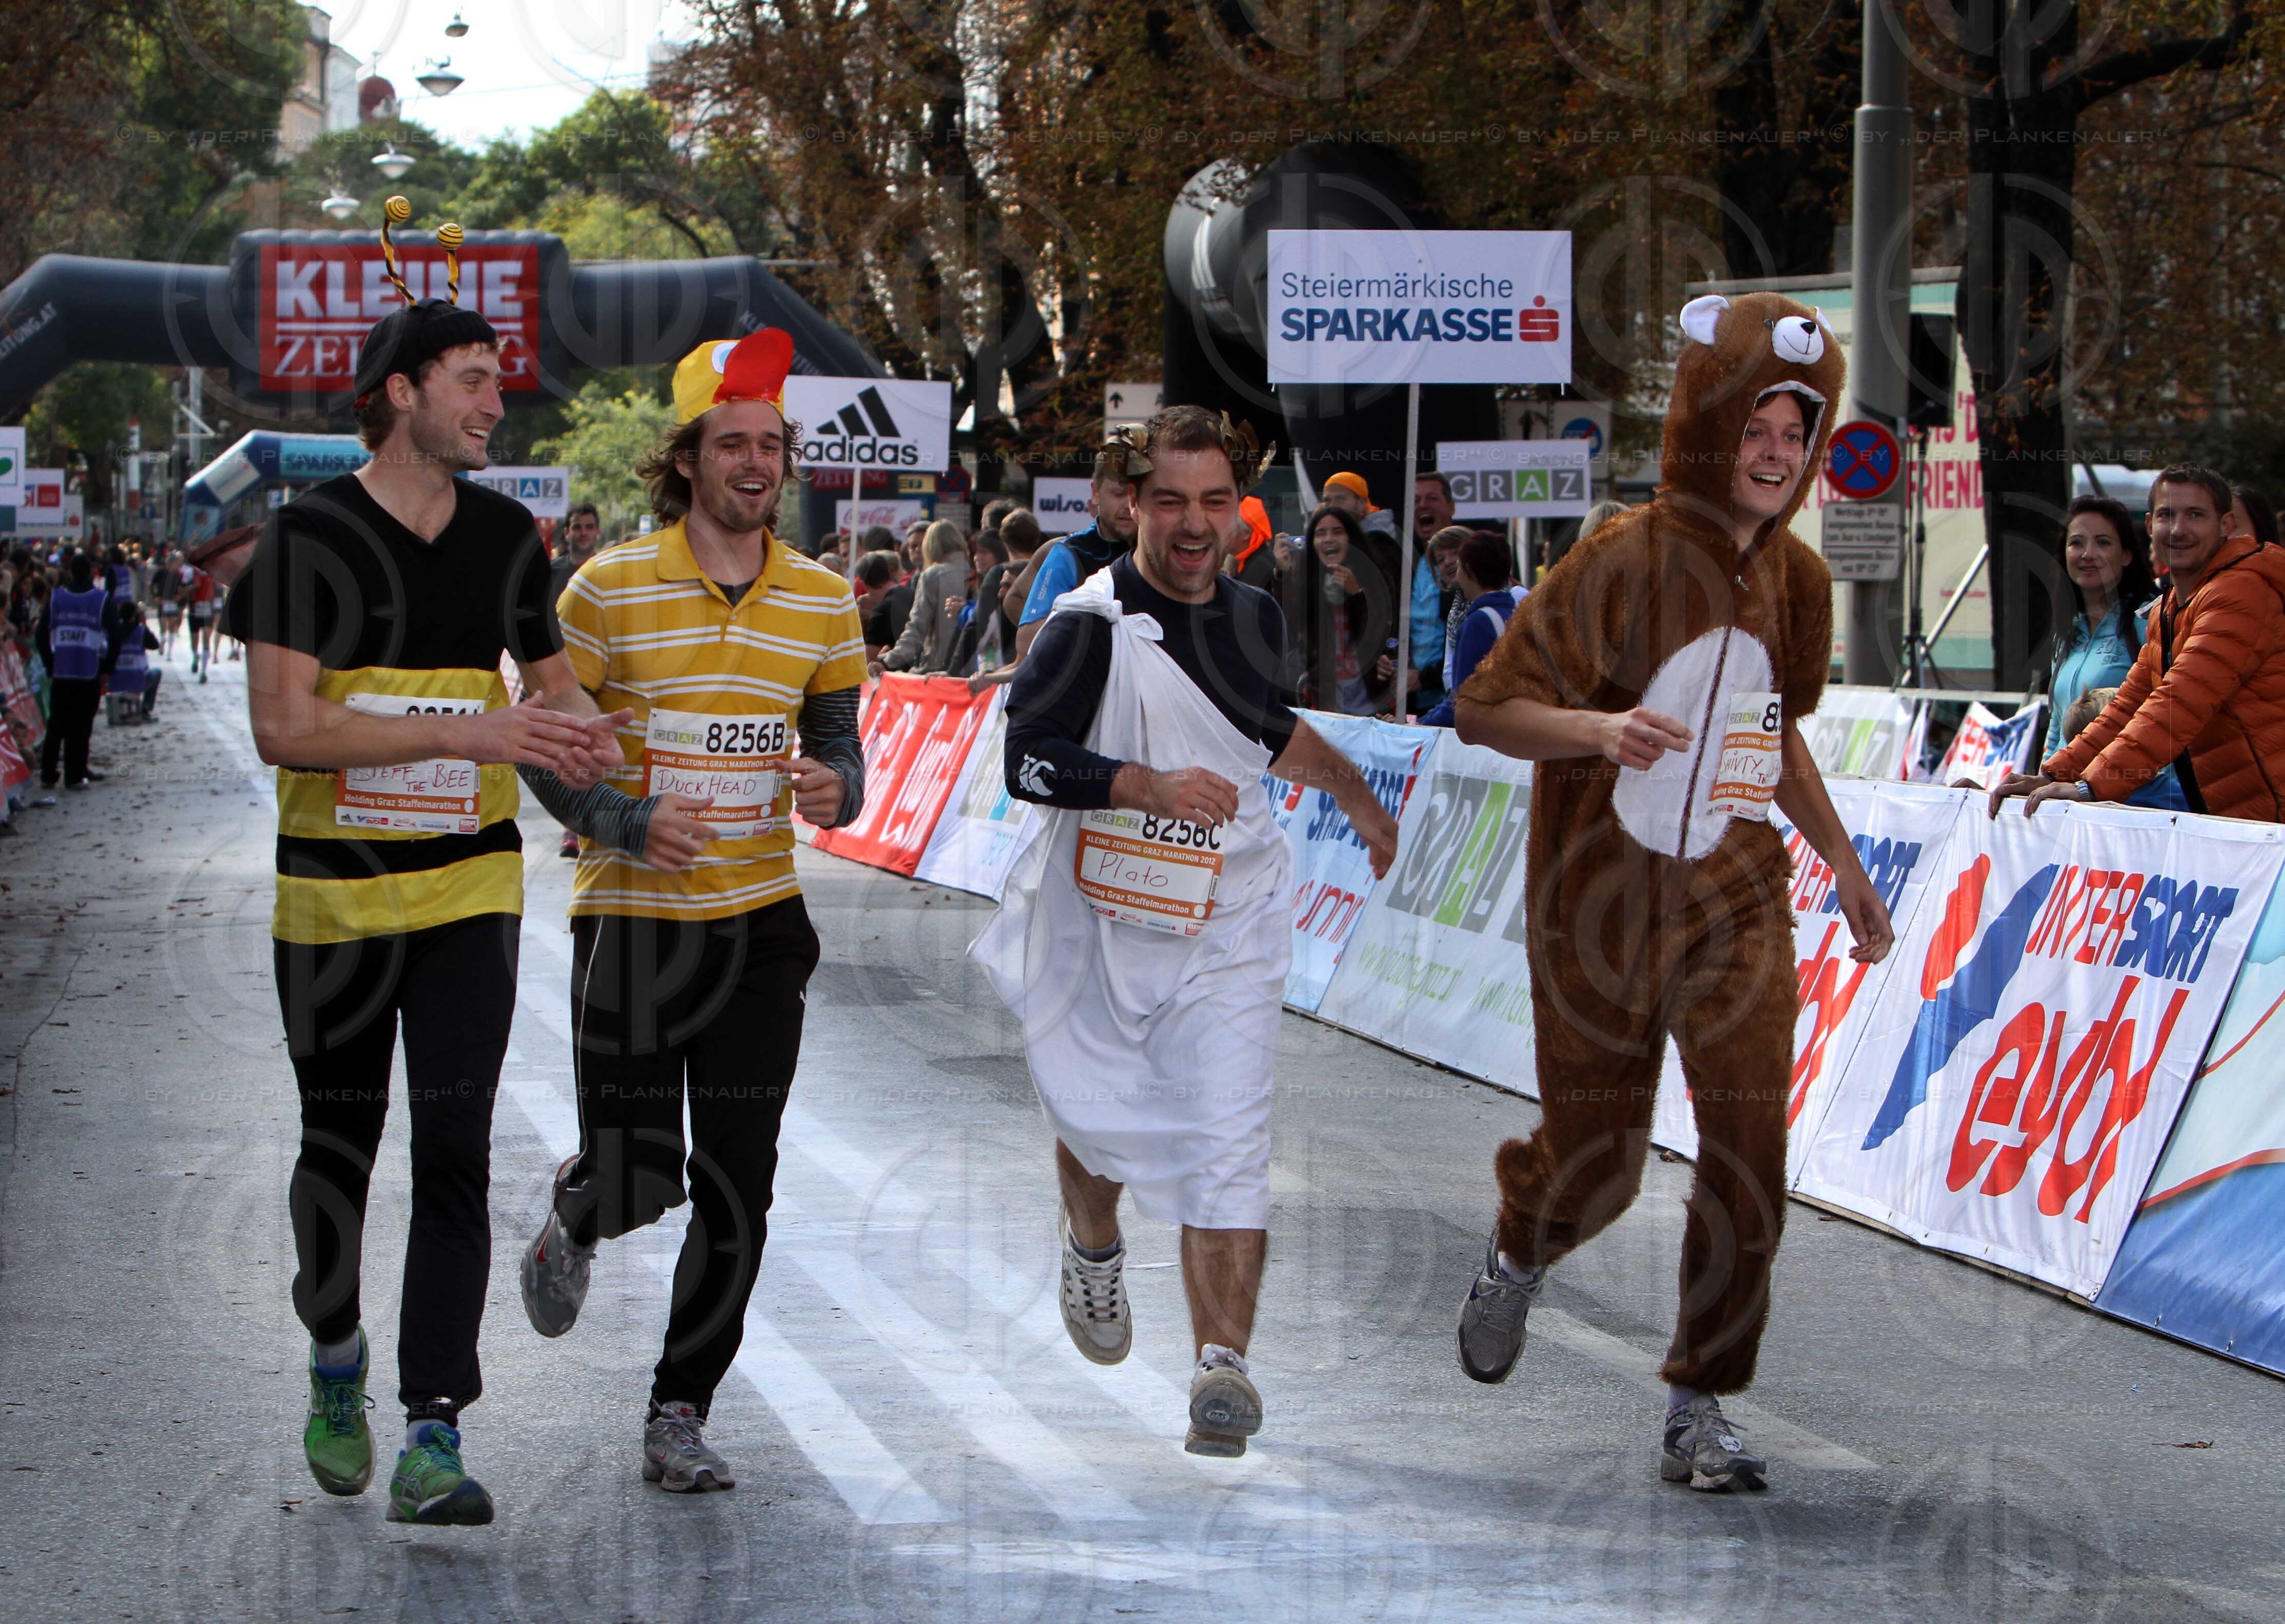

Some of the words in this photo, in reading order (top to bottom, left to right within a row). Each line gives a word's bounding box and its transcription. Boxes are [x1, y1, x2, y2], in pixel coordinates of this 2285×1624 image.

[276, 260, 523, 318] KLEINE
[1282, 272, 1513, 298] Steiermärkische
[1281, 308, 1513, 342] SPARKASSE
[804, 436, 918, 466] adidas
[1451, 471, 1582, 501] GRAZ
[1039, 492, 1090, 512] wiso
[654, 729, 703, 745] GRAZ
[706, 722, 785, 753] 8256B
[432, 763, 471, 788] BEE
[652, 753, 676, 764] KLEINE
[677, 758, 707, 767] ZEITUNG
[709, 760, 728, 768] GRAZ
[729, 760, 764, 768] MARATHON
[344, 795, 375, 807] Holding
[377, 797, 396, 808] Graz
[398, 799, 461, 811] Staffelmarathon
[1728, 786, 1742, 796] Graz
[698, 807, 757, 819] Staffelmarathon
[1091, 811, 1140, 830] GRAZ
[1086, 834, 1110, 846] KLEINE
[1112, 840, 1141, 853] ZEITUNG
[1143, 847, 1161, 857] GRAZ
[1163, 851, 1199, 863] MARATHON
[1200, 856, 1216, 865] 2012
[1098, 852, 1168, 887] Plato
[1079, 881, 1105, 898] Holding
[1107, 891, 1125, 902] Graz
[1127, 895, 1189, 915] Staffelmarathon
[2026, 864, 2239, 983] INTERSPORT
